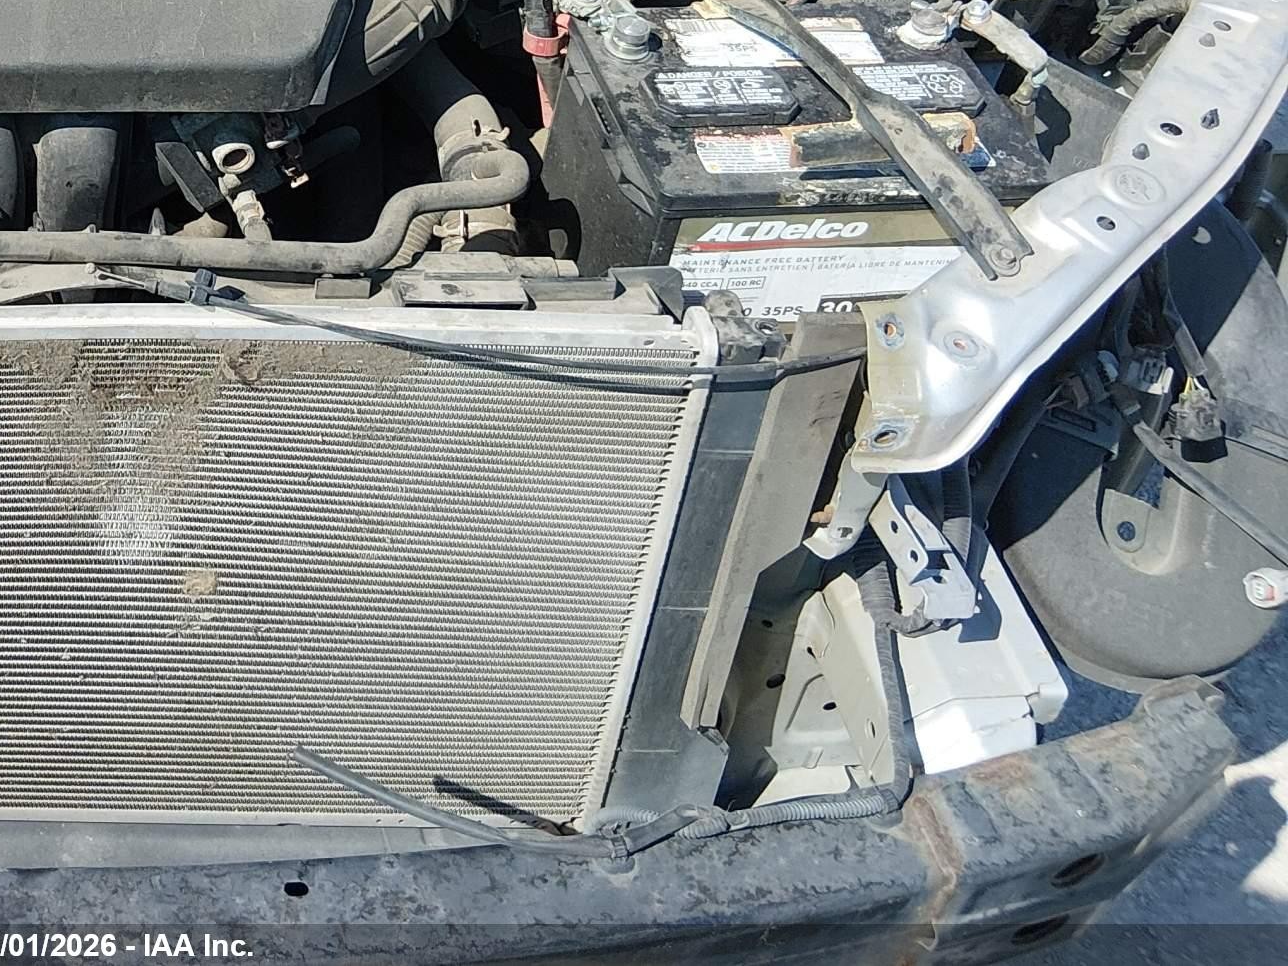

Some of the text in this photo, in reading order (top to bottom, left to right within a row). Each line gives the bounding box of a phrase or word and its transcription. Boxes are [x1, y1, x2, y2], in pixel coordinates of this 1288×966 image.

[669, 71, 712, 79] DANGER
[722, 69, 764, 77] POISON
[696, 218, 869, 242] ACDelco
[764, 256, 791, 264] FREE
[795, 254, 846, 263] BATTERY
[700, 280, 719, 288] CCA
[761, 305, 804, 317] 35PS
